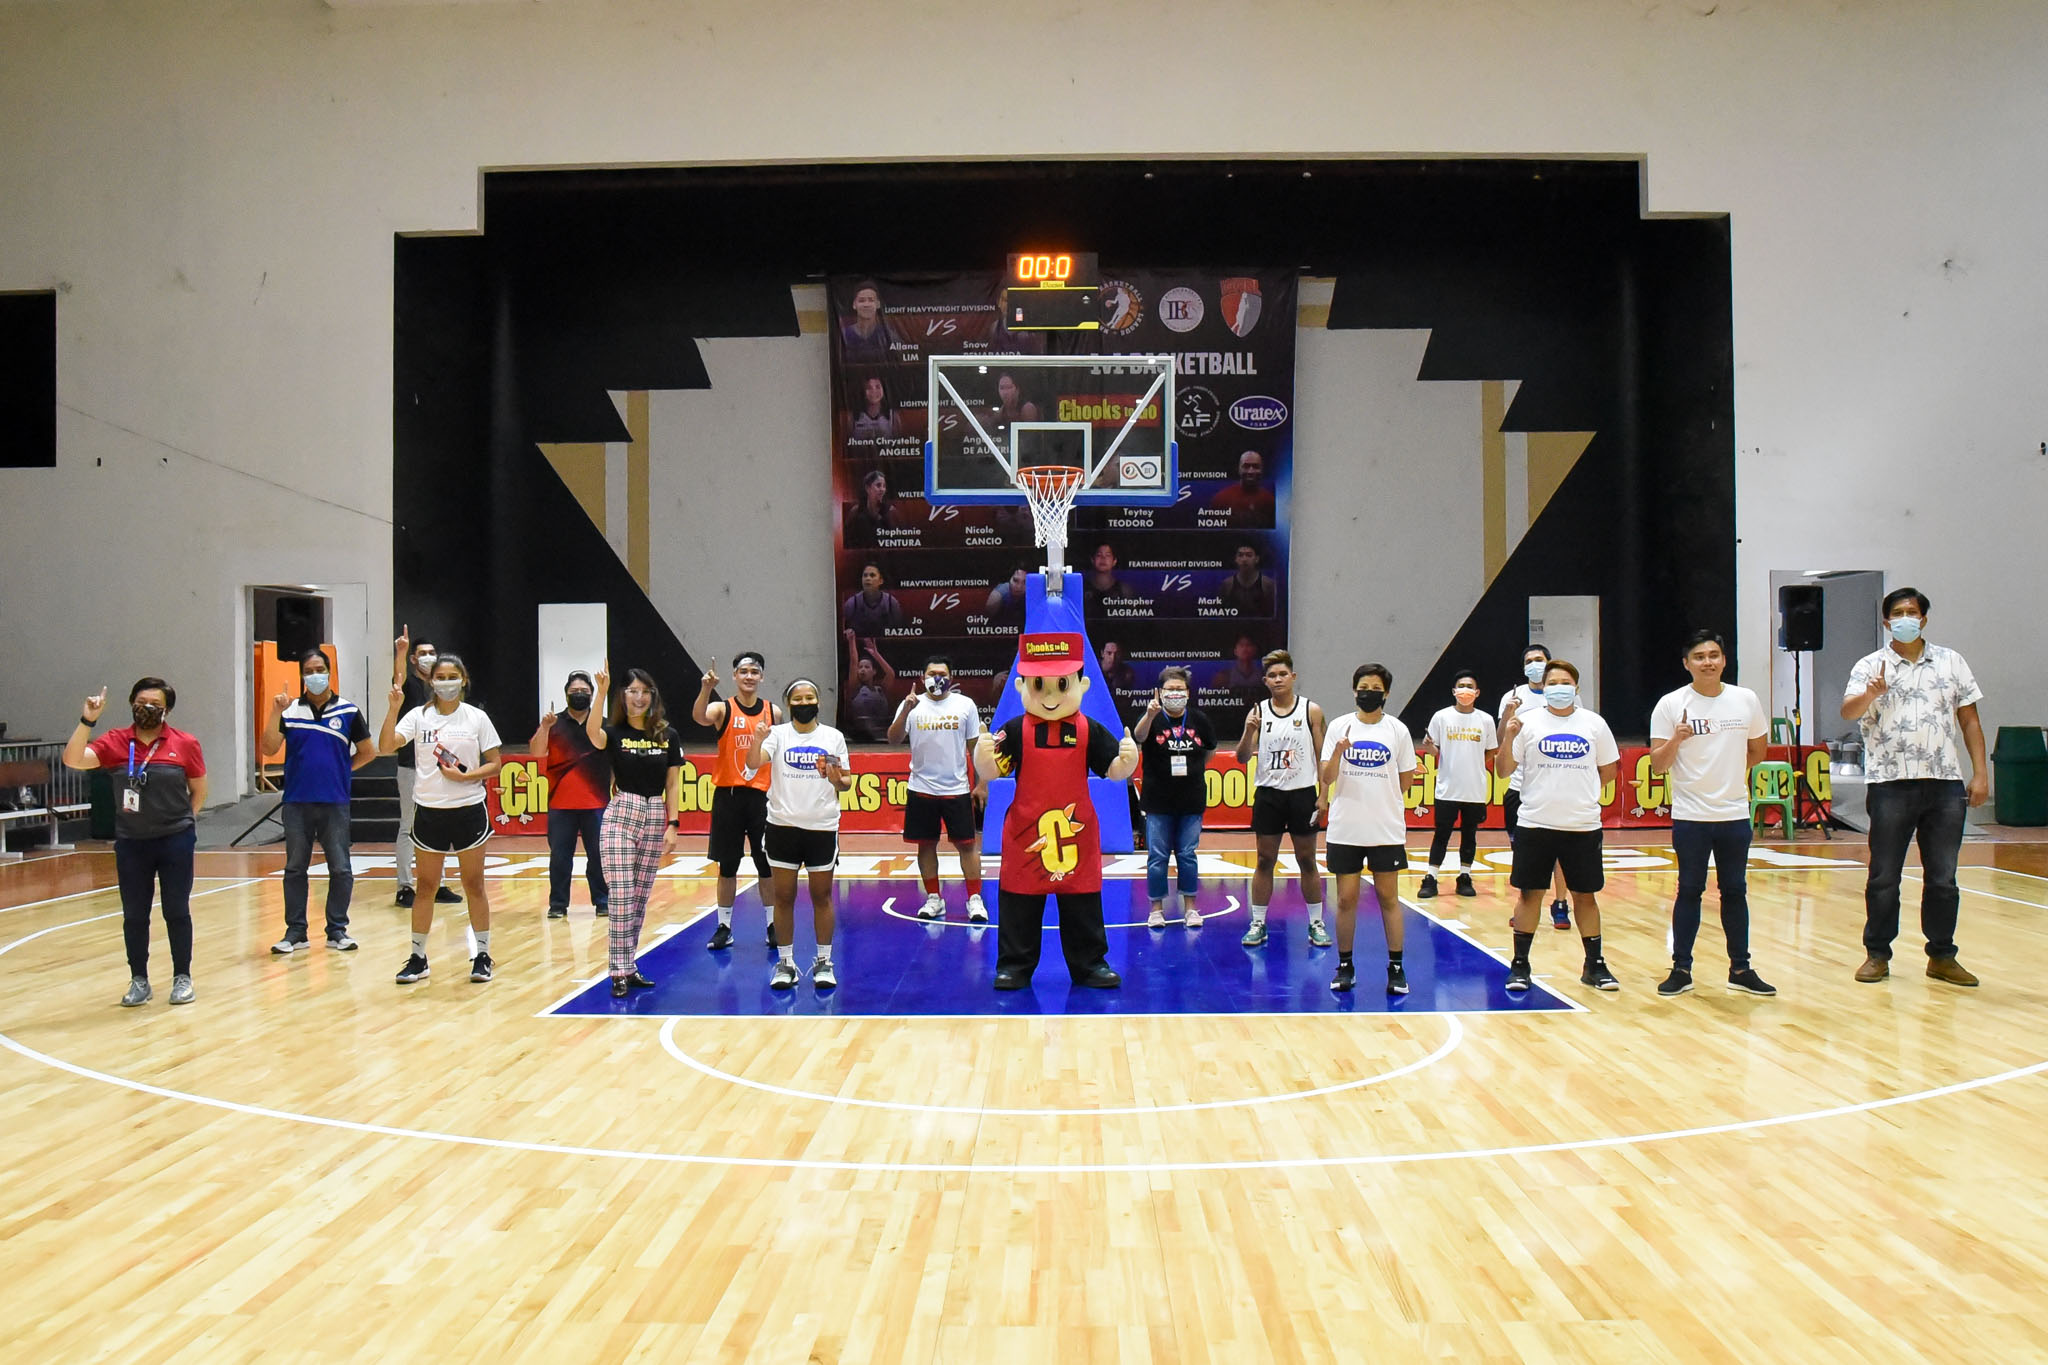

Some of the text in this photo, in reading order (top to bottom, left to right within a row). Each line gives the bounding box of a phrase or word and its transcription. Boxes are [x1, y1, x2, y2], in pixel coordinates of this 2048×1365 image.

[1019, 256, 1070, 278] 00:0
[926, 318, 957, 336] VS
[890, 342, 919, 350] Allana
[963, 341, 989, 349] Snow
[902, 353, 919, 361] LIM
[1059, 399, 1121, 421] Chooks
[1234, 406, 1284, 421] Uratex
[848, 436, 921, 447] Jhenn Chrystelle
[879, 448, 920, 457] ANGELES
[929, 505, 959, 521] VS
[1123, 508, 1153, 518] Teytey
[1198, 507, 1231, 516] Arnaud
[1108, 519, 1154, 527] TEODORO
[1198, 519, 1227, 527] NOAH
[876, 528, 921, 538] Stephanie
[965, 526, 994, 534] Nicole
[878, 539, 921, 547] VENTURA
[965, 537, 1002, 545] CANCIO
[1161, 574, 1192, 591] VS
[930, 593, 960, 611] VS
[1102, 597, 1154, 606] Christopher
[1198, 597, 1222, 605] Mark
[1198, 608, 1238, 616] TAMAYO
[912, 617, 922, 625] Jo
[967, 615, 989, 625] Girly
[885, 628, 923, 636] RAZALO
[967, 626, 1018, 635] VILLFLORES
[1115, 688, 1154, 697] Raymart
[1198, 687, 1229, 695] Marvin
[1198, 698, 1244, 706] BARACAEL
[733, 716, 746, 728] 13
[1266, 721, 1273, 733] 7
[1168, 740, 1192, 748] PLAY
[1541, 740, 1589, 754] Uratex
[785, 751, 819, 764] Urate
[1345, 747, 1389, 762] Uratex
